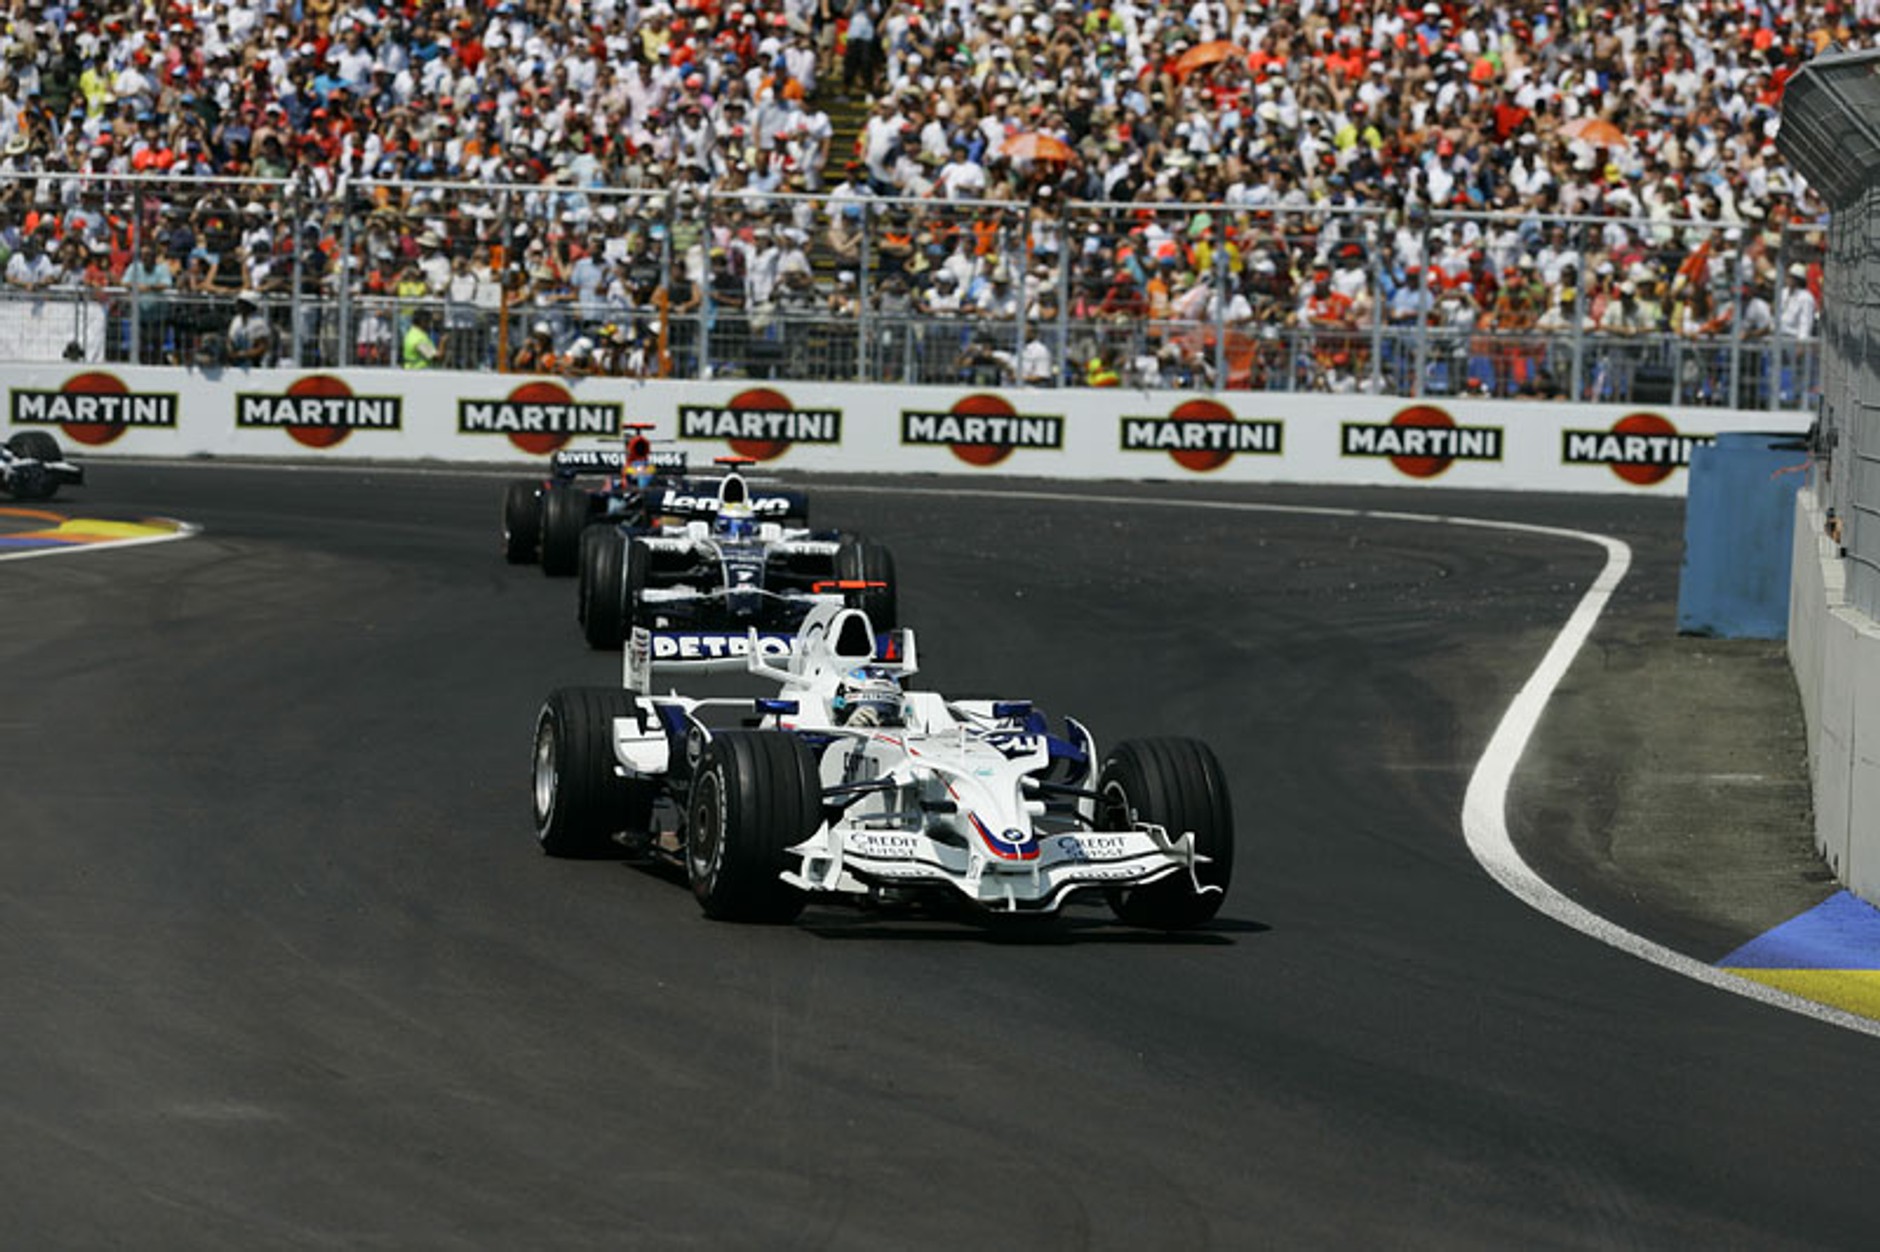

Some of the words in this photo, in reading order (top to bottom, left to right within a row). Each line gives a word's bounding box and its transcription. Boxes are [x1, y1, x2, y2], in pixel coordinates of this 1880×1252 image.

[18, 394, 169, 423] MARTINI
[243, 398, 394, 425] MARTINI
[465, 404, 614, 431] MARTINI
[685, 410, 834, 438] MARTINI
[909, 416, 1057, 444] MARTINI
[1127, 421, 1275, 449] MARTINI
[1347, 427, 1495, 455] MARTINI
[557, 452, 598, 465] GIVES
[647, 453, 682, 466] INGS
[661, 490, 790, 515] lenvo
